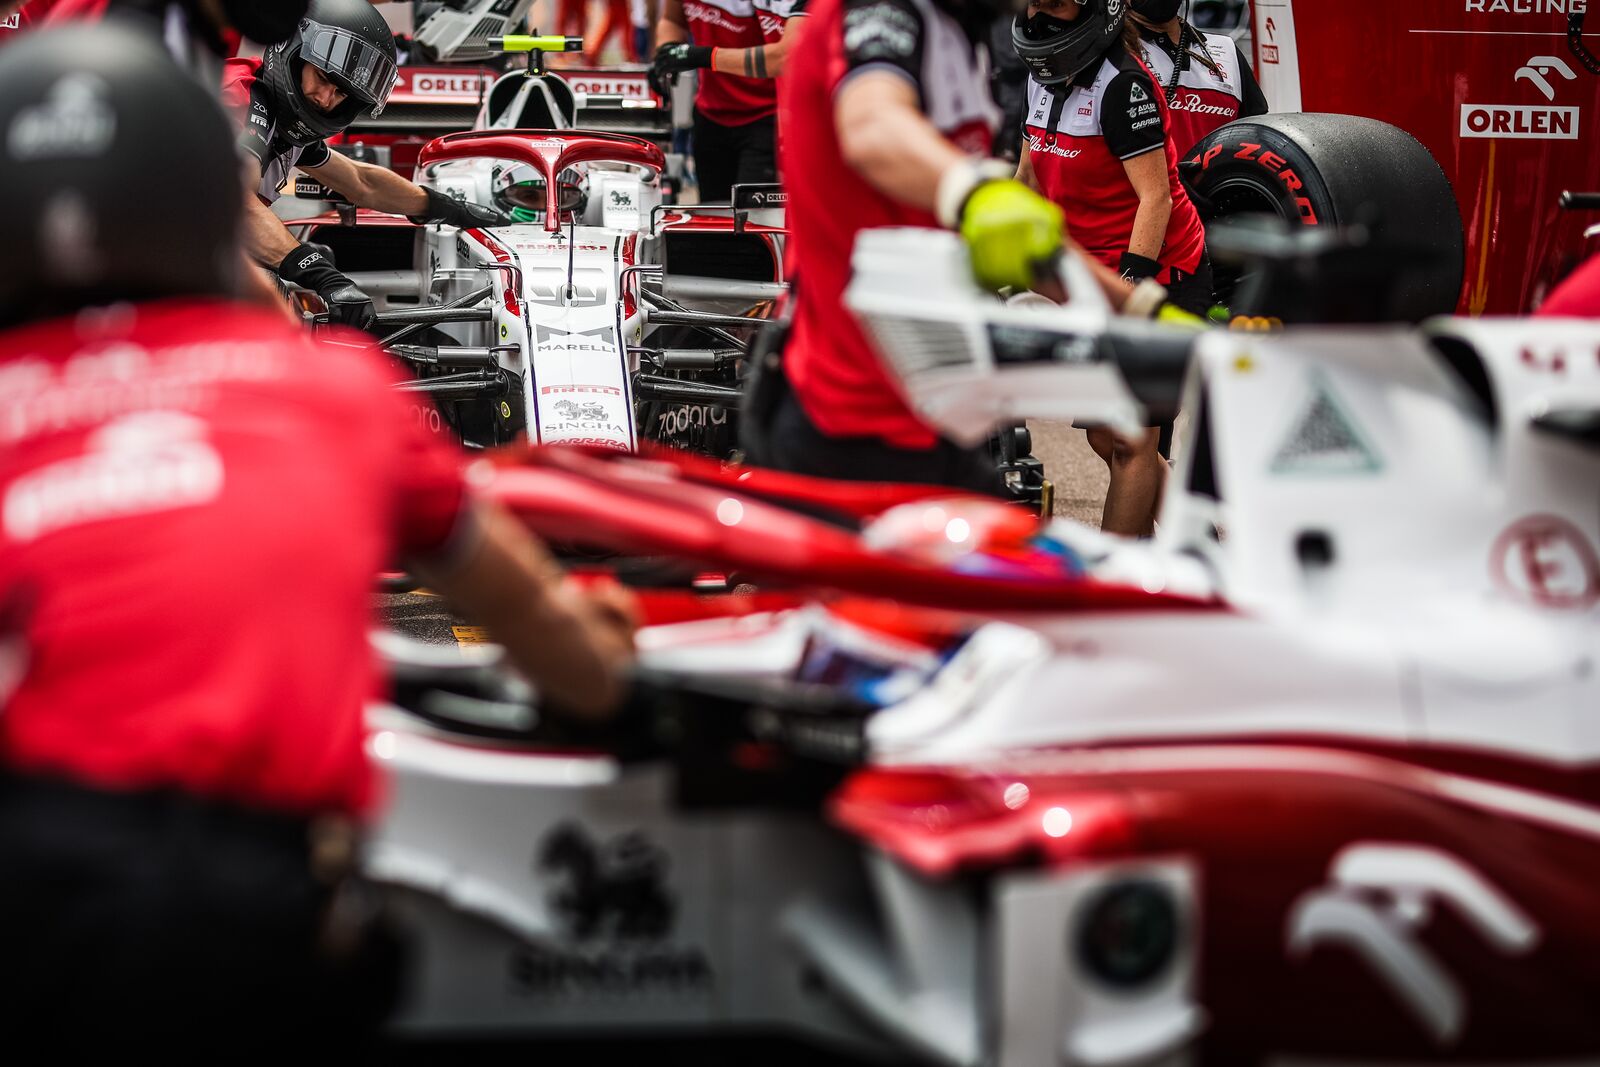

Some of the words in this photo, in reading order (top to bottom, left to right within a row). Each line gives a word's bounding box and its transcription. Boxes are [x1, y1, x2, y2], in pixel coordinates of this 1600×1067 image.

[1465, 0, 1587, 14] RACING
[1466, 109, 1572, 134] ORLEN
[537, 344, 617, 354] MARELLI
[544, 421, 625, 433] SINGHA
